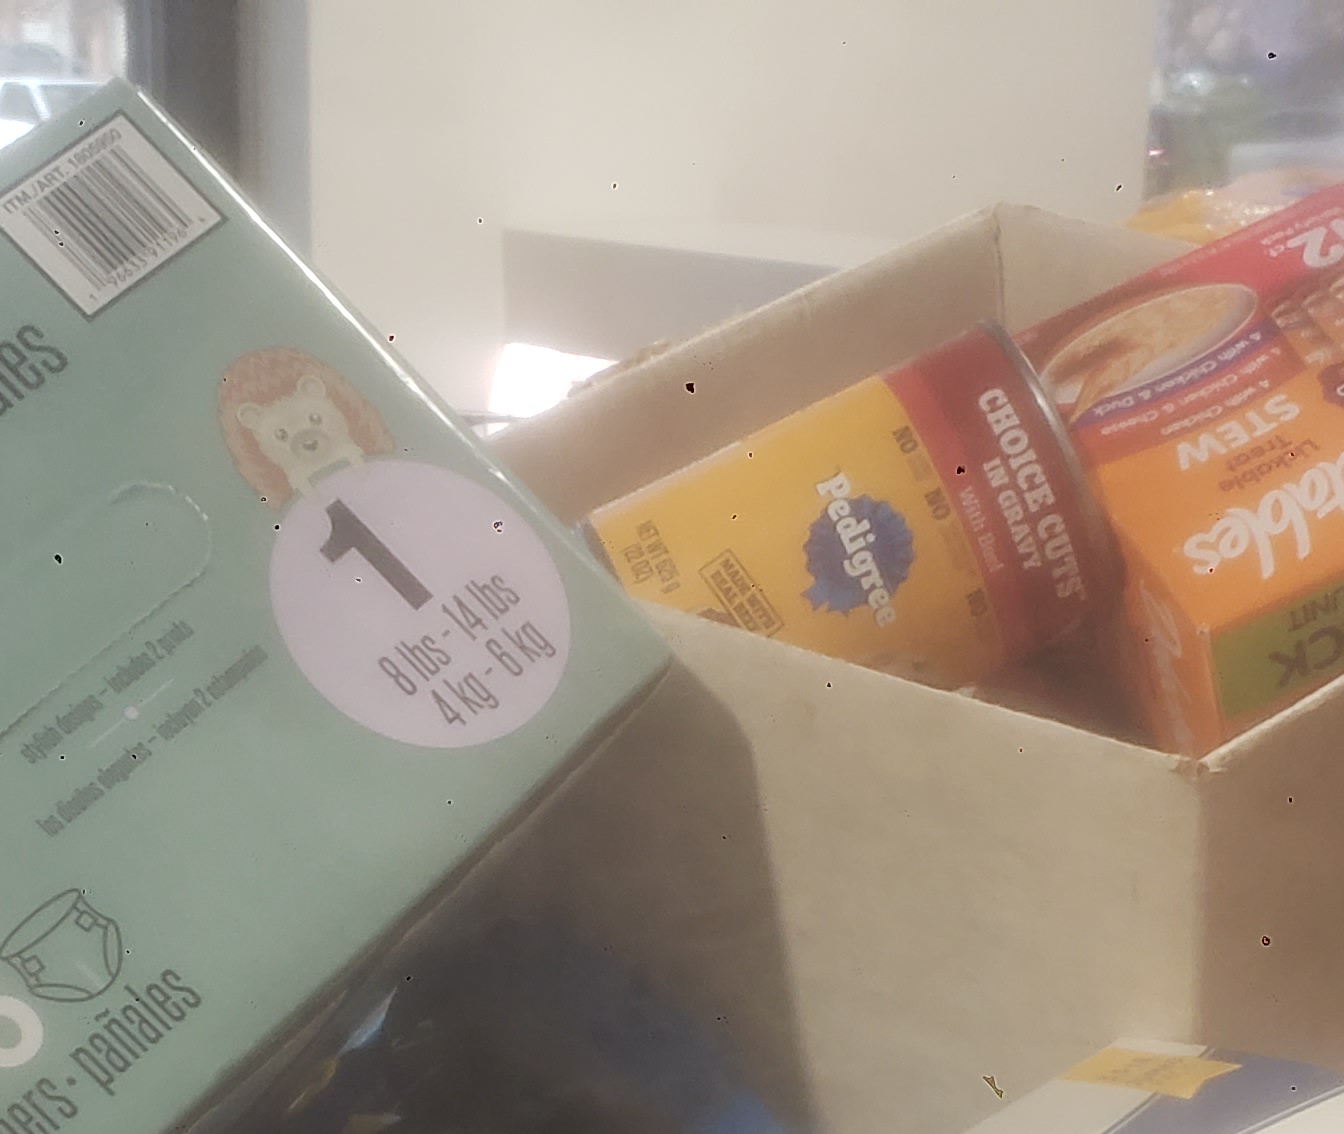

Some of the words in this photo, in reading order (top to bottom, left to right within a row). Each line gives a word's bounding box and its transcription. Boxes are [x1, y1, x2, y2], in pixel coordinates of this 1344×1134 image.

[1092, 395, 1136, 417] Duck
[1176, 393, 1301, 471] STEW
[959, 484, 985, 533] With
[978, 388, 1055, 512] CHOICE
[1036, 513, 1084, 598] CUTS
[982, 455, 1009, 488] IN
[997, 489, 1043, 570] GRAVY
[319, 498, 435, 611] 1
[815, 470, 898, 629] Pedigree
[441, 595, 489, 642] 14
[464, 575, 521, 621] lbs
[144, 640, 165, 661] 2
[394, 640, 452, 683] lbs
[485, 638, 524, 677] 6
[501, 620, 557, 663] kg
[192, 686, 212, 708] 2
[378, 656, 418, 696] 8
[442, 672, 500, 716] kg
[431, 689, 467, 726] 4
[69, 968, 202, 1097] pañales
